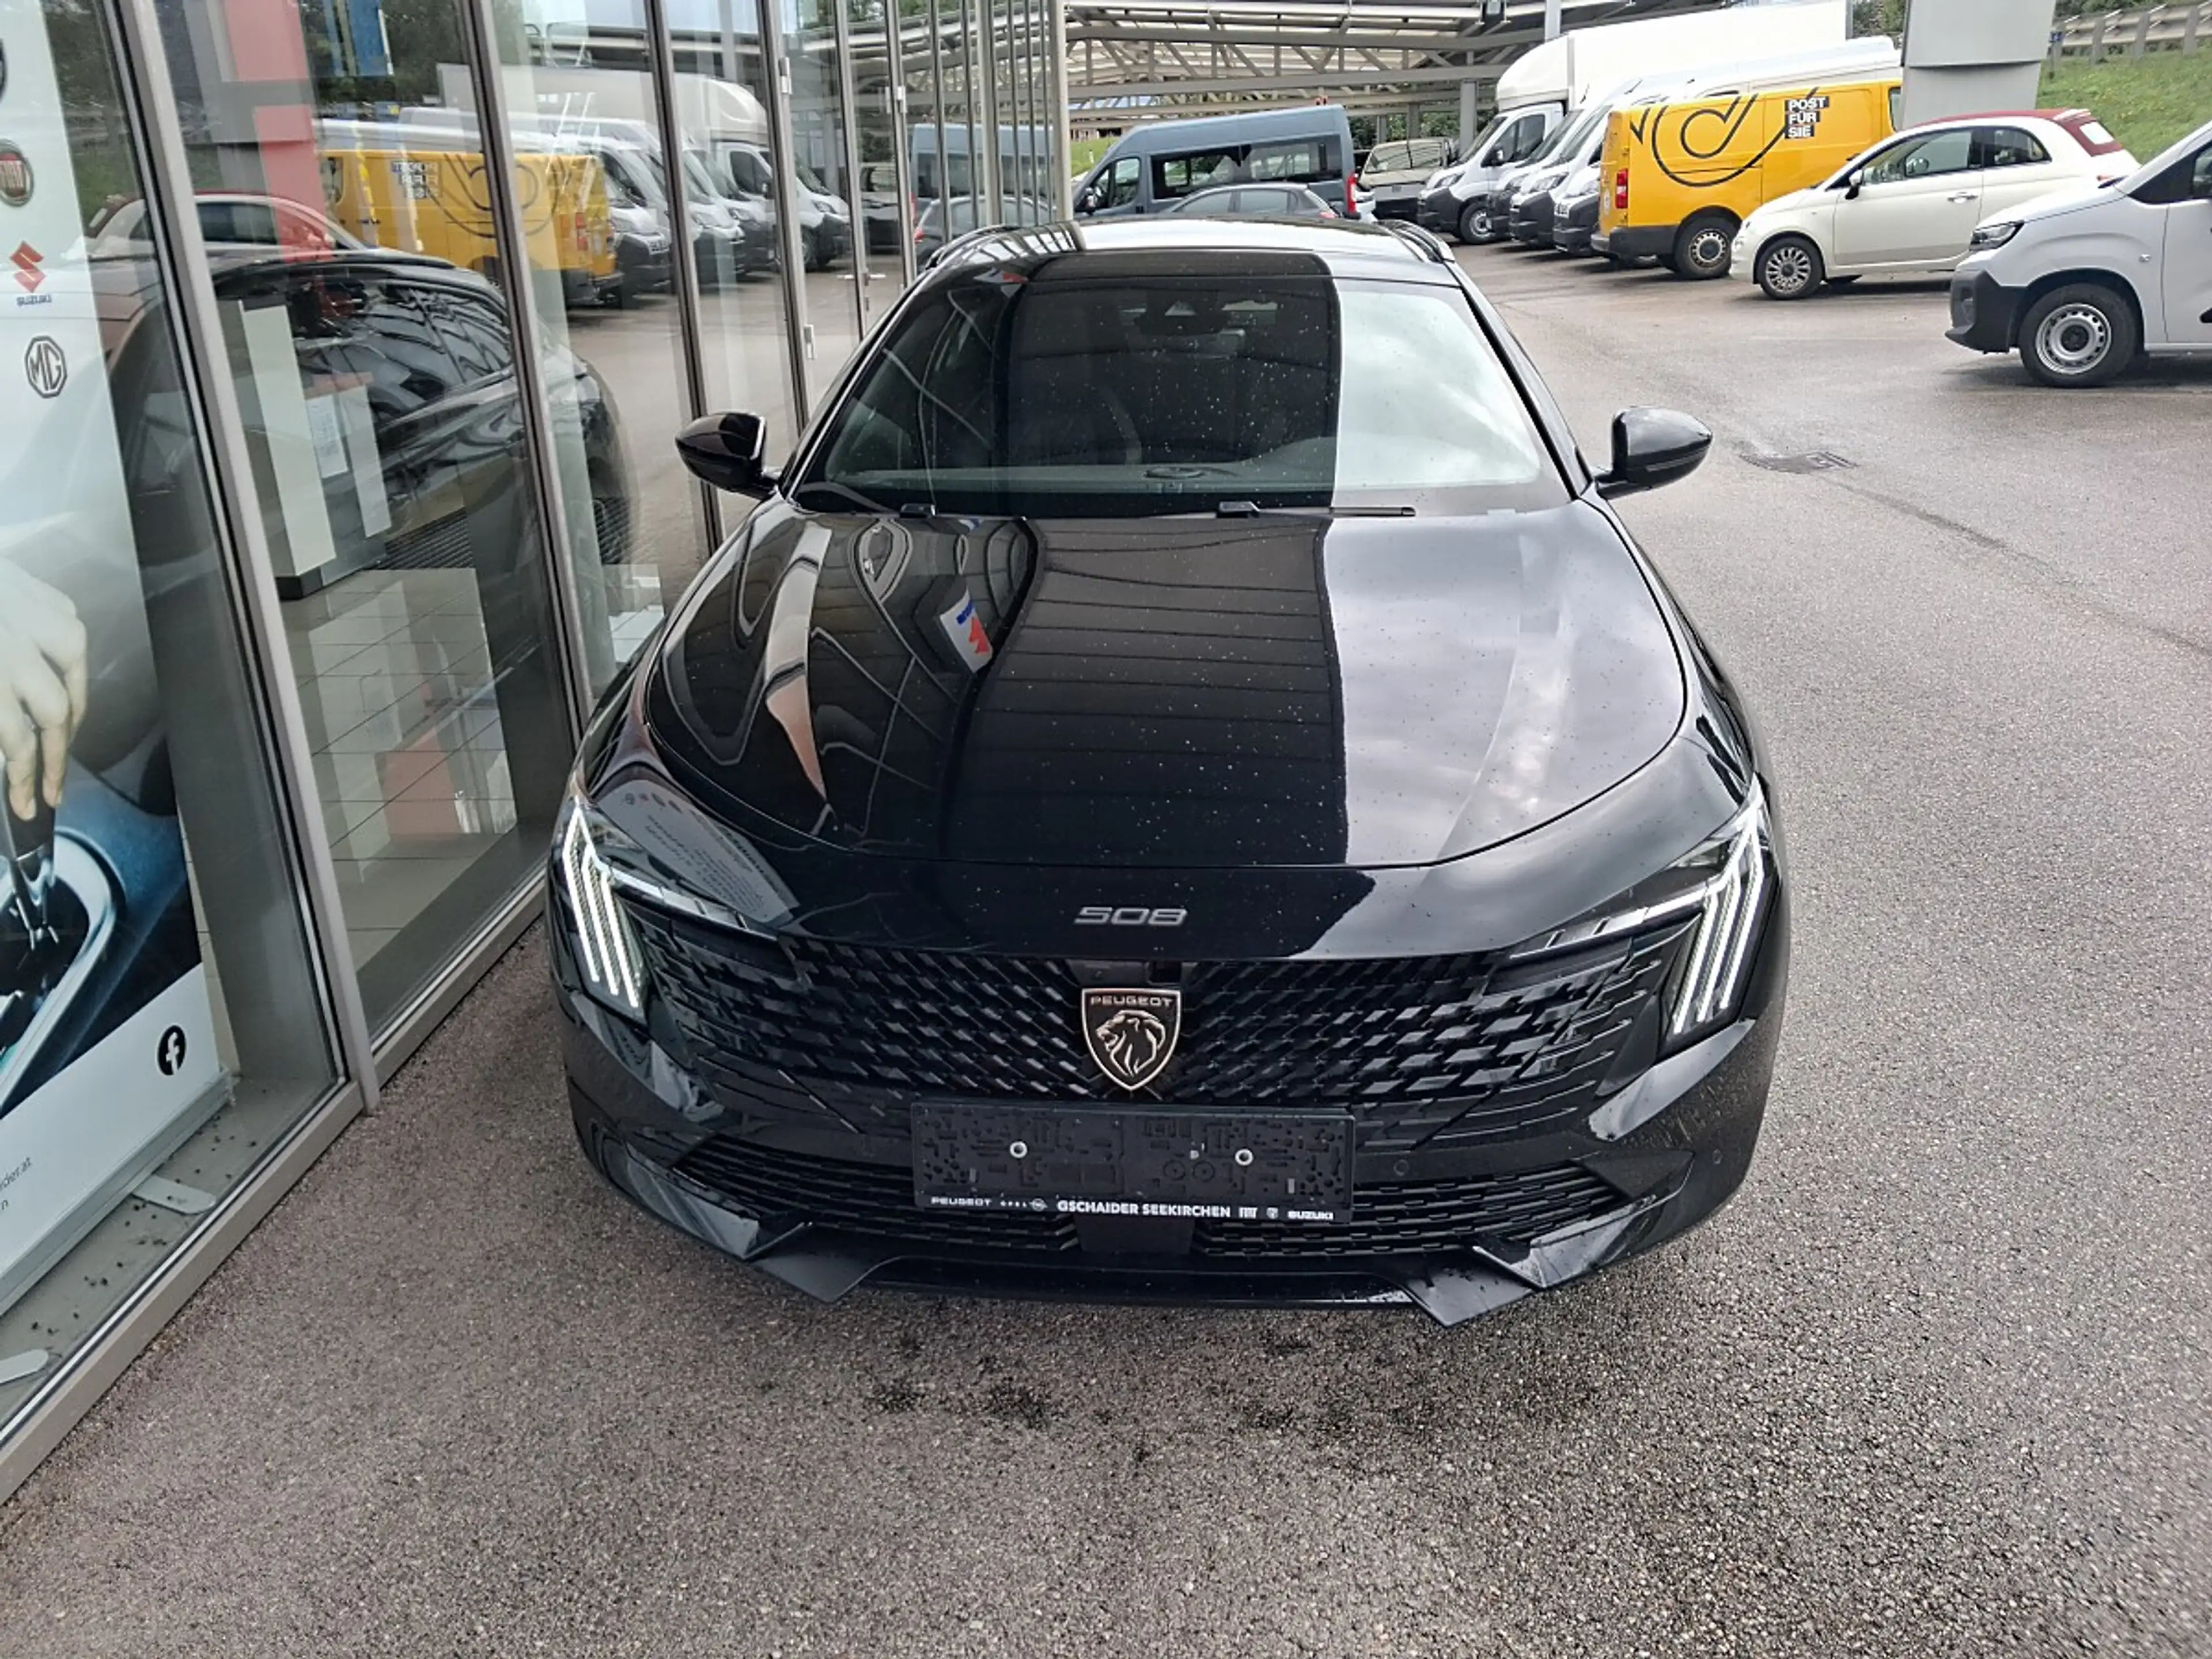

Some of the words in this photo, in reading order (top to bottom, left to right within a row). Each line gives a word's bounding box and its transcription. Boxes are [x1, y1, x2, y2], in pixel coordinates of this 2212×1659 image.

[1788, 97, 1825, 111] POST
[1789, 110, 1817, 124] FÜR
[1788, 126, 1811, 137] SIE
[29, 343, 62, 391] MG
[1074, 907, 1188, 925] 508
[1090, 995, 1173, 1007] PEUGEOT
[931, 1196, 991, 1207] PEUGEOT
[1057, 1200, 1138, 1215] GSCHAIDER
[1142, 1203, 1231, 1218] SEEKIRCHEN
[1288, 1210, 1334, 1221] SUZUKI
